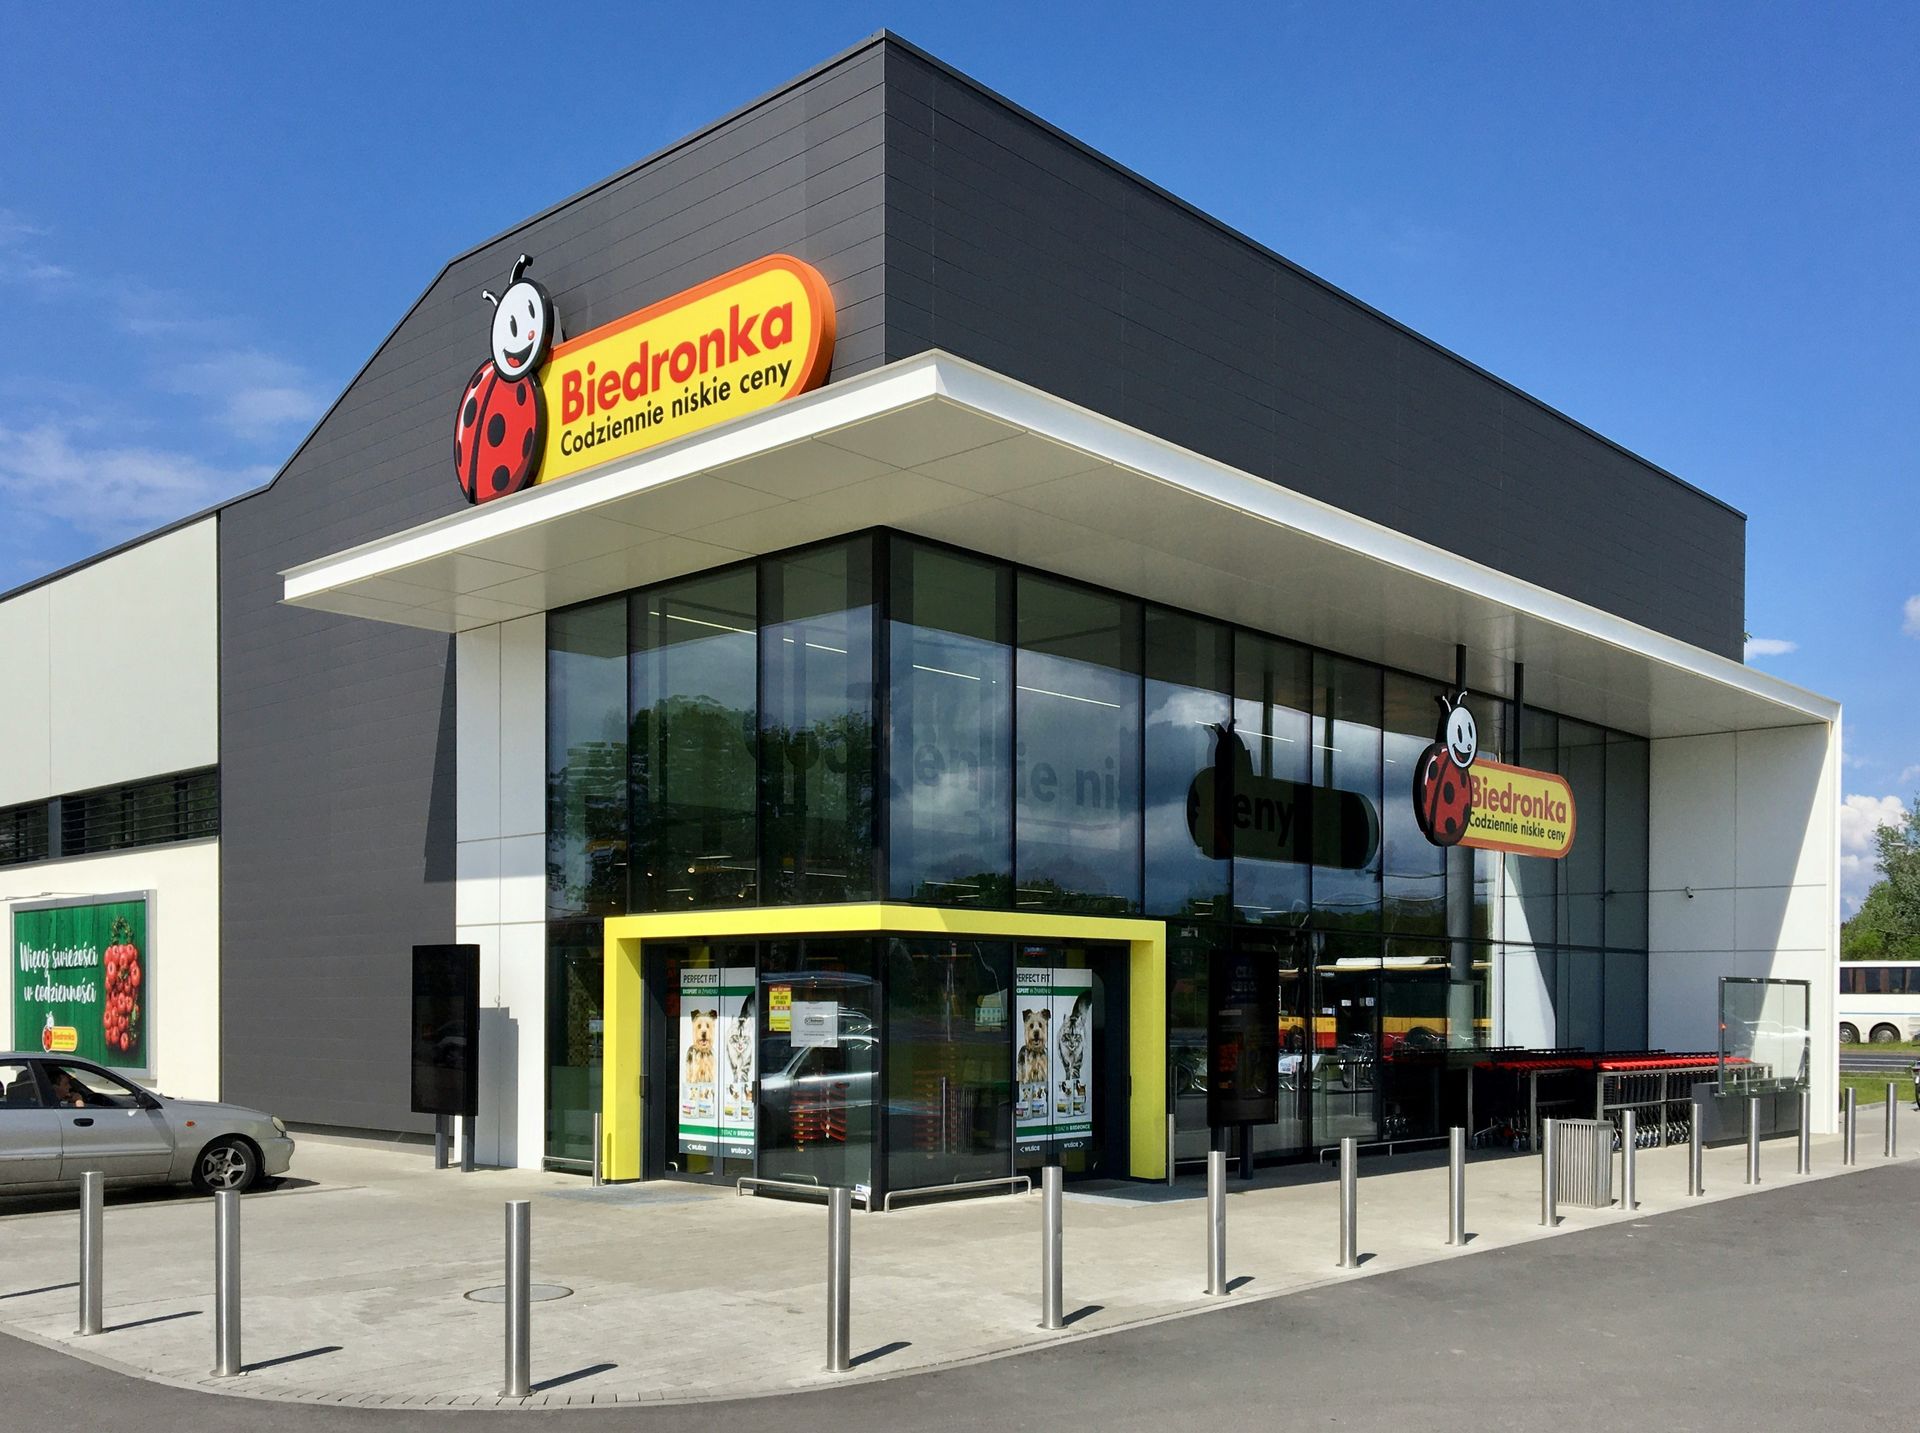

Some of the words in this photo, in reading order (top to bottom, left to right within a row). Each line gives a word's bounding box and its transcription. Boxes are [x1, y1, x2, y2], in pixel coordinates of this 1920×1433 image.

[561, 301, 793, 426] Biedronka
[561, 402, 664, 456] Codziennie
[671, 378, 732, 419] niskie
[739, 359, 793, 395] ceny
[1471, 775, 1567, 824] Biedronka
[1469, 811, 1518, 834] Codziennie
[1520, 819, 1545, 838] niskie
[1547, 828, 1566, 844] ceny
[20, 942, 50, 978] Więcej
[52, 941, 98, 969] świeżości
[24, 986, 34, 1001] w
[34, 975, 97, 1004] codzienności
[683, 974, 708, 984] PERFECT
[709, 974, 718, 983] FIT
[1041, 973, 1050, 983] FIT
